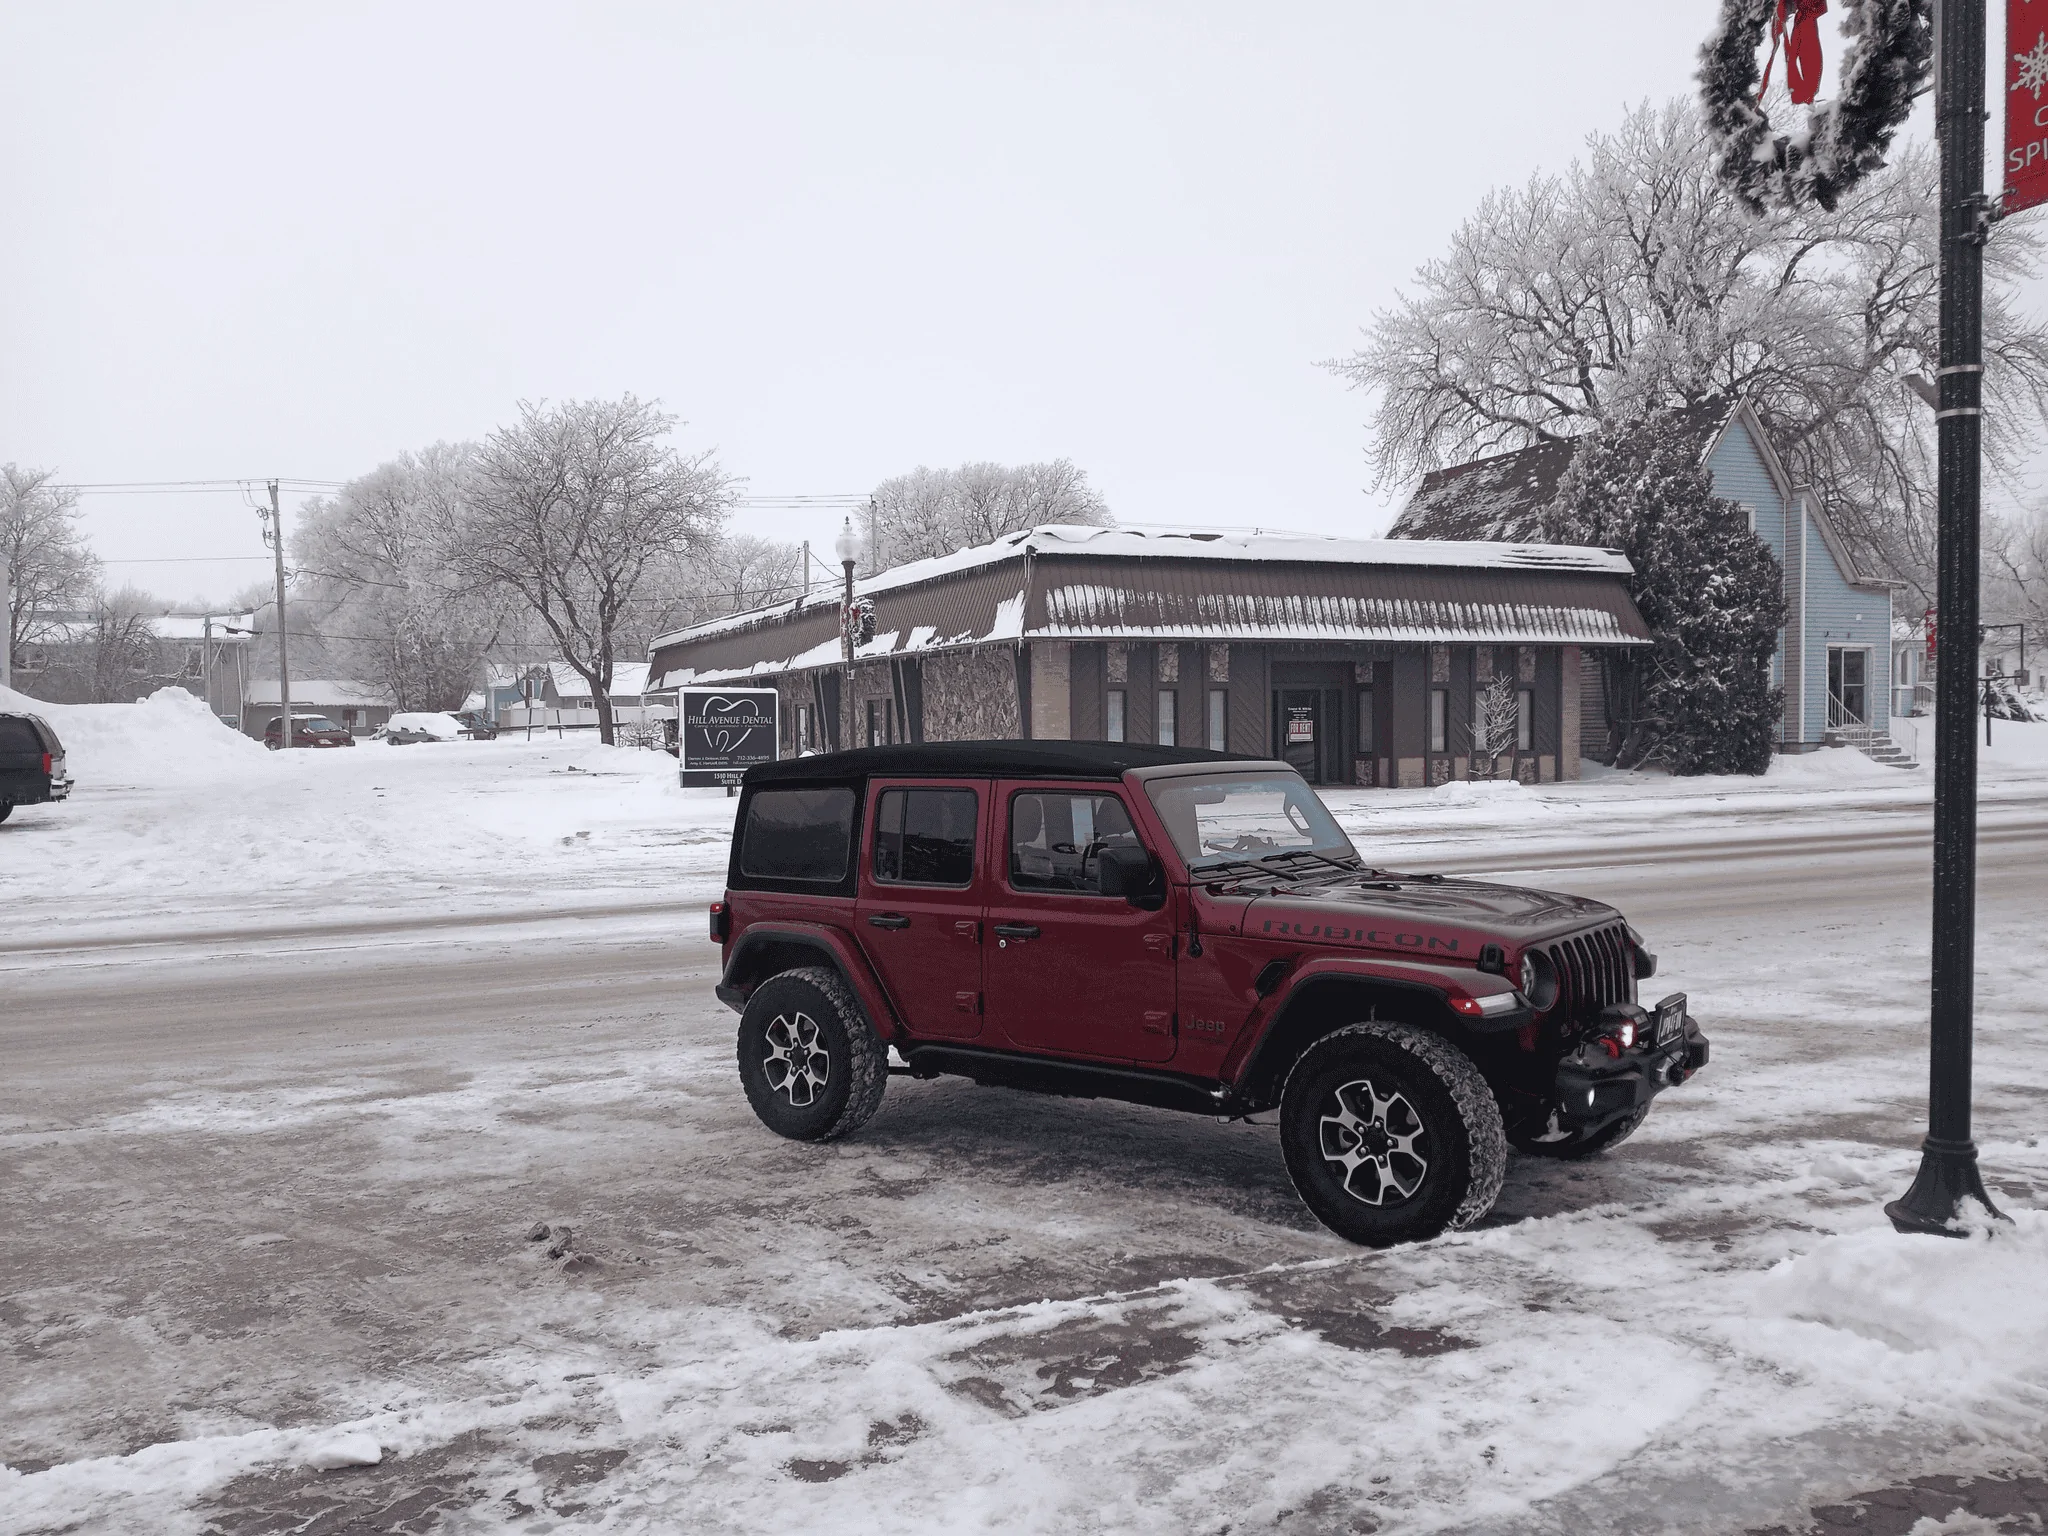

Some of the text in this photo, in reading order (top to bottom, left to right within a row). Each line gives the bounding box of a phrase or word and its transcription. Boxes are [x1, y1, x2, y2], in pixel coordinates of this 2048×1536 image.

[688, 715, 773, 724] HILL AVENUE DENTAL
[1300, 723, 1310, 732] RENT
[1262, 920, 1459, 951] RUBICON
[1184, 1014, 1226, 1036] Jeep
